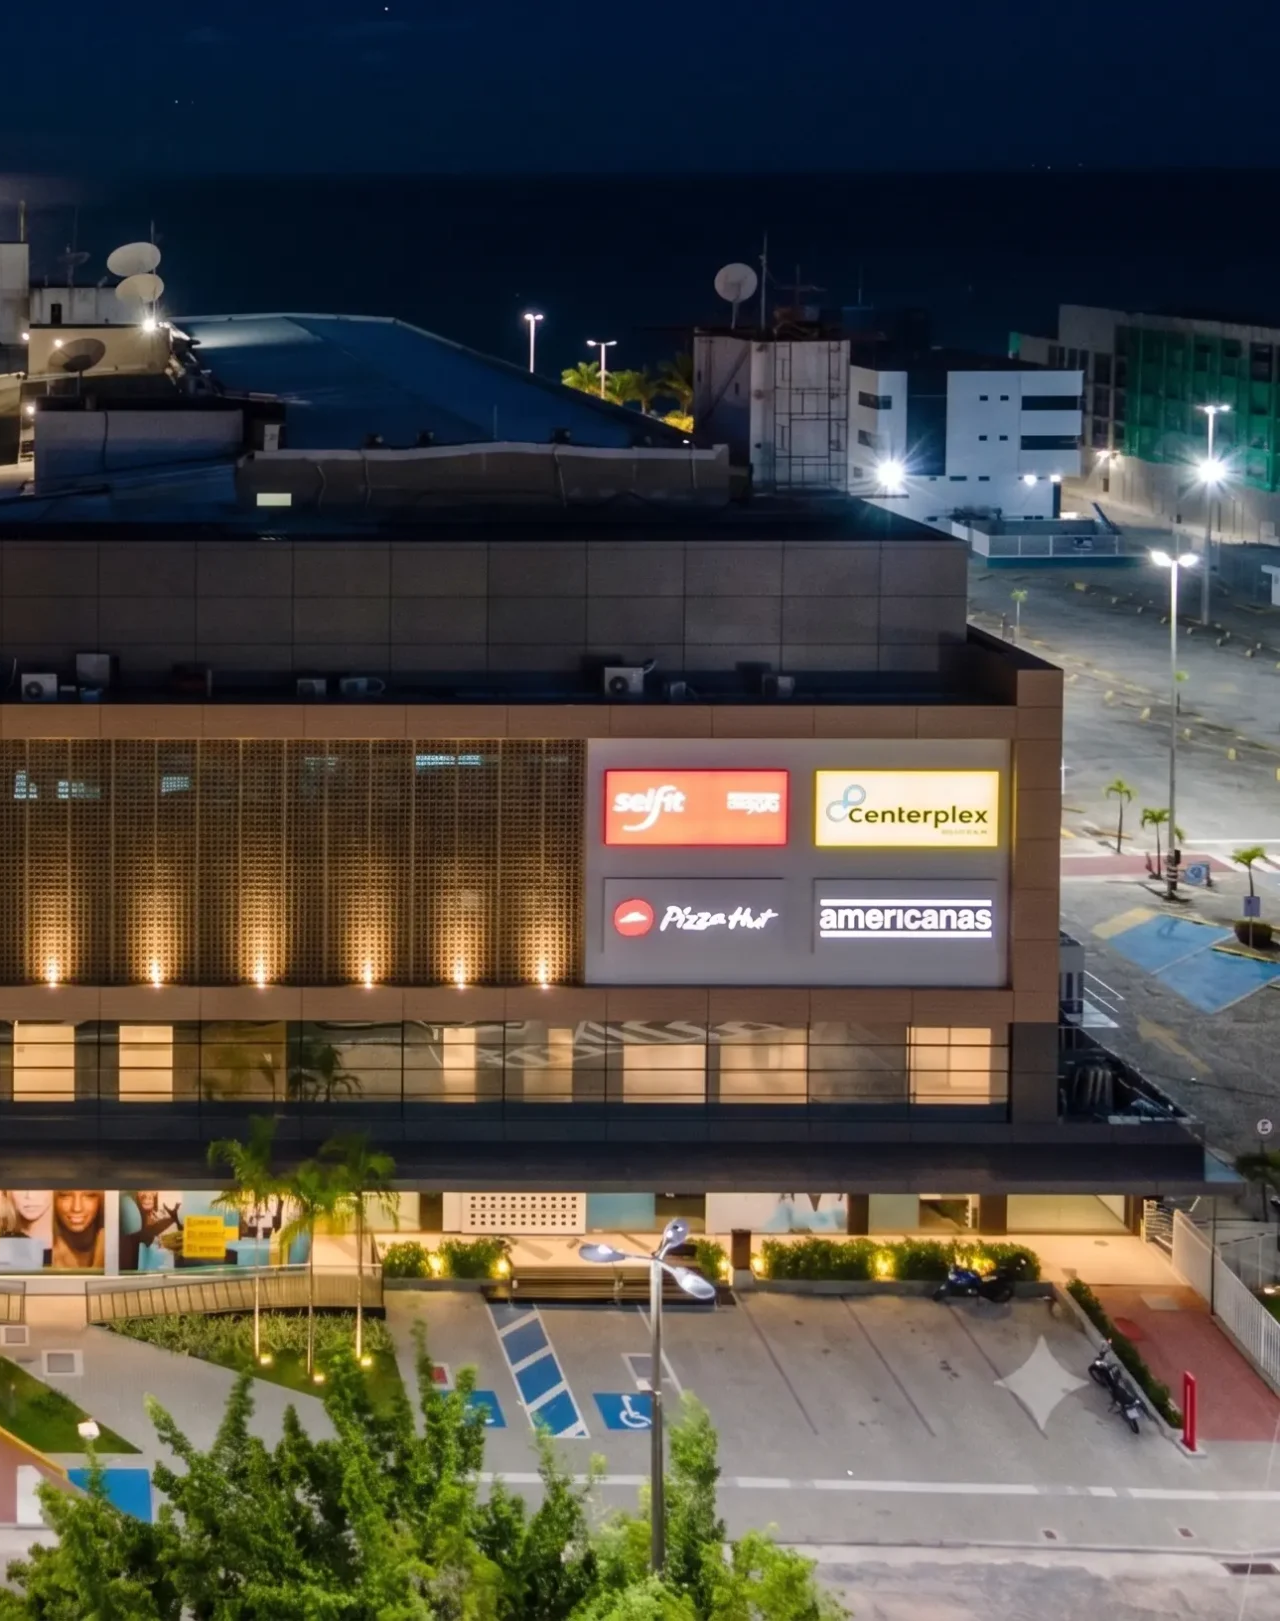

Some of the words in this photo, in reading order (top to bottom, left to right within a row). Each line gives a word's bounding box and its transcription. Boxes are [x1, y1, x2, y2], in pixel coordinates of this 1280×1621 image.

[612, 785, 686, 831] selfit
[660, 906, 726, 931] Pizza
[728, 906, 779, 930] Hut
[819, 908, 992, 930] americanas
